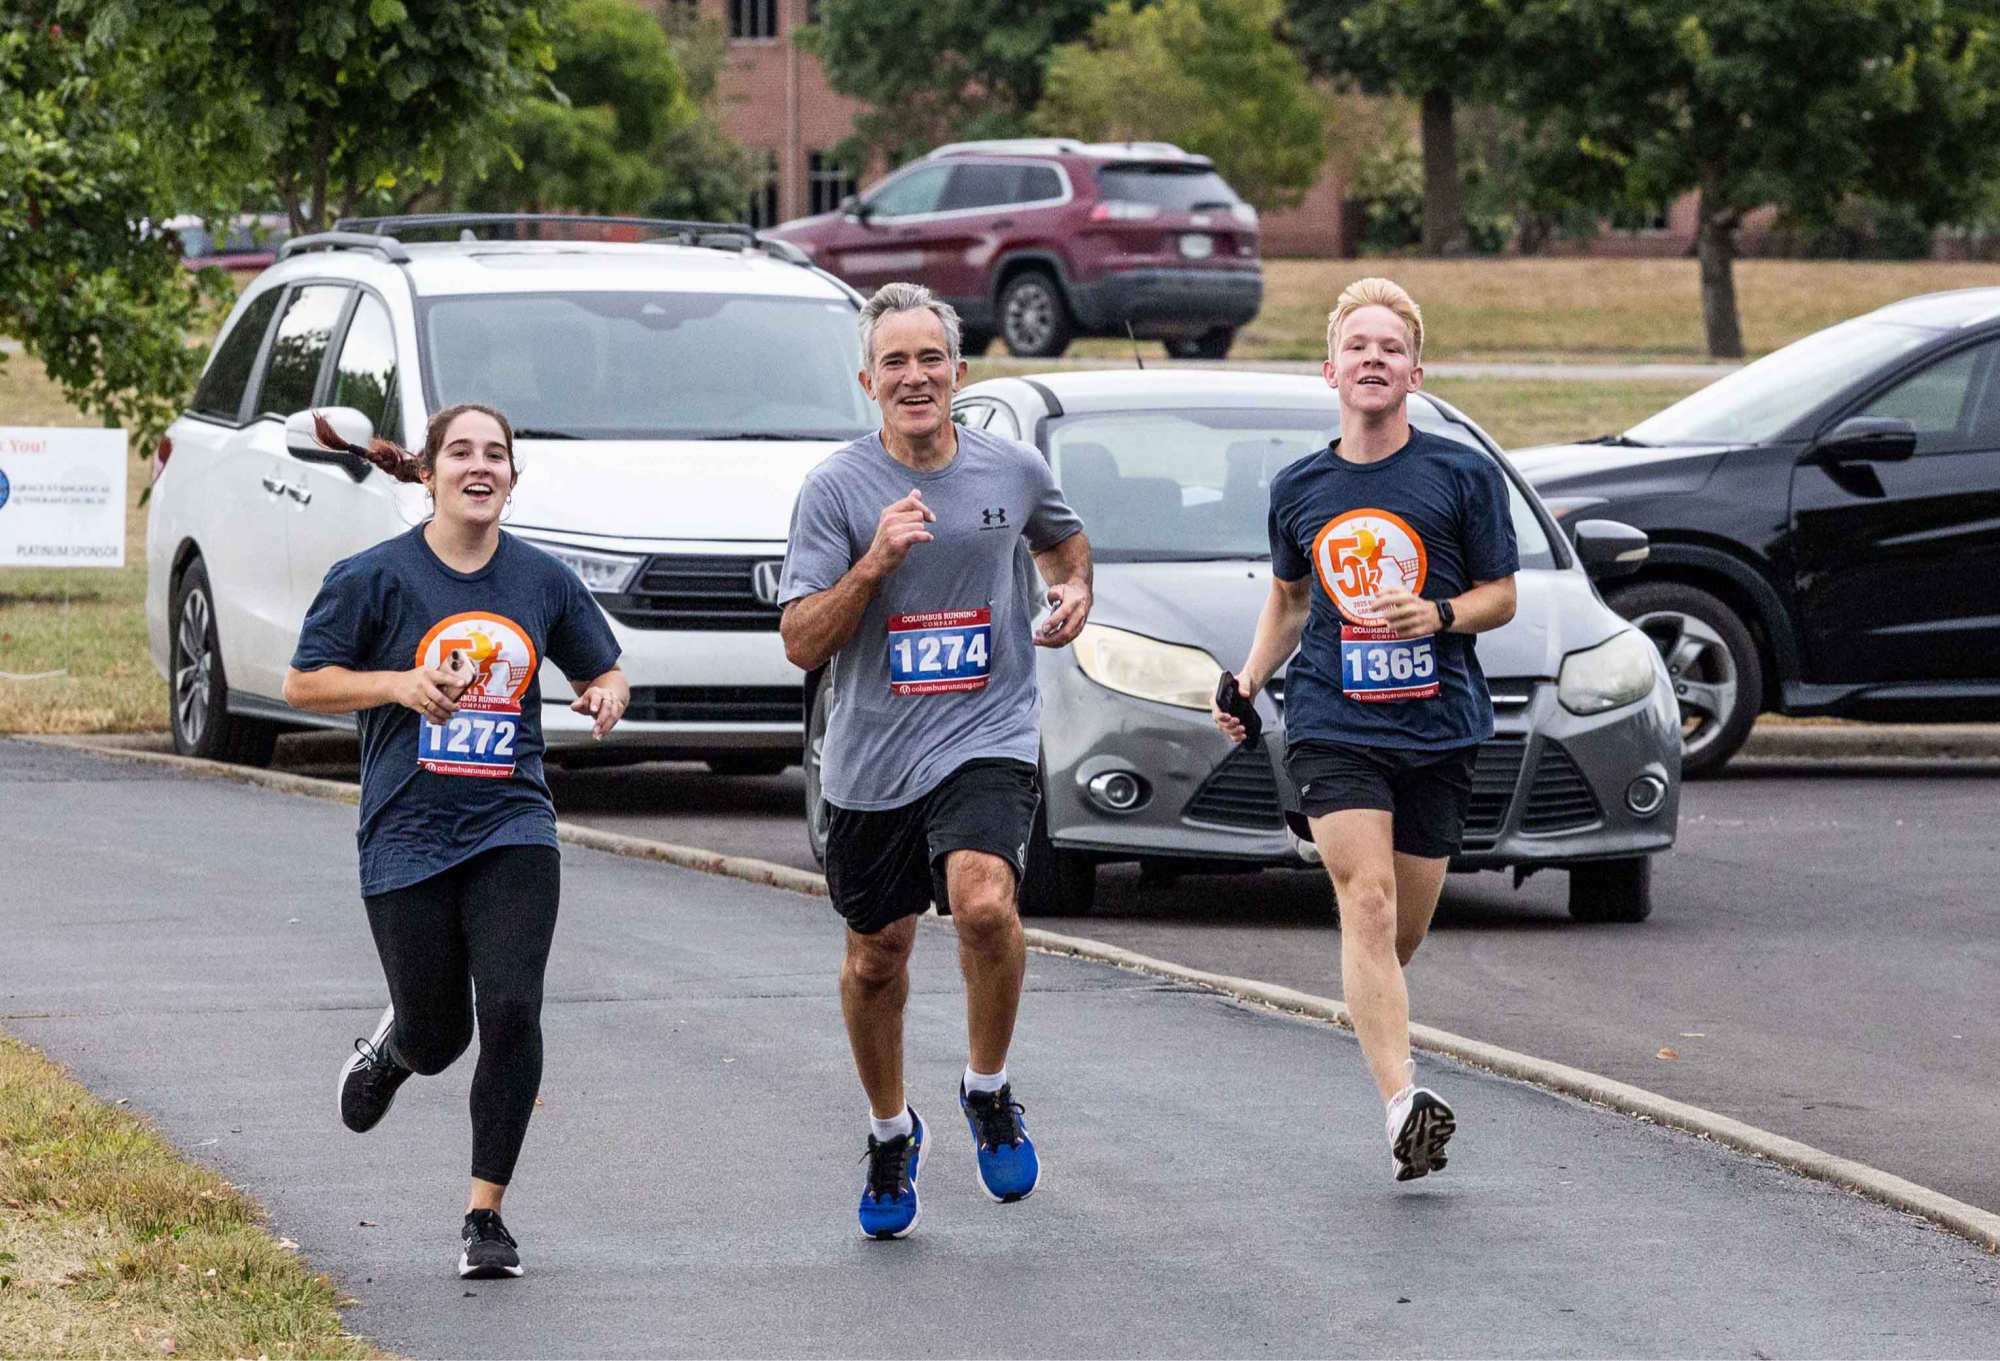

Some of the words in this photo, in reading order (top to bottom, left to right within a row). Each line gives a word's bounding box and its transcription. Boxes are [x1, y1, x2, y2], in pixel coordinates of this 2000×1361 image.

[10, 440, 46, 453] You!
[17, 544, 68, 557] PLATINUM
[69, 545, 118, 558] SPONSOR
[902, 613, 942, 623] COLUMBUS
[943, 611, 978, 620] RUNNING
[1352, 626, 1390, 634] COLUMBUS
[895, 634, 988, 673] 1274
[1346, 644, 1434, 682] 1365
[911, 681, 985, 692] columbusrunning.com
[478, 696, 511, 705] RUNNING
[1362, 689, 1434, 700] columbusrunning.com
[425, 717, 516, 756] 1272
[437, 765, 509, 777] columbusrunning.com
